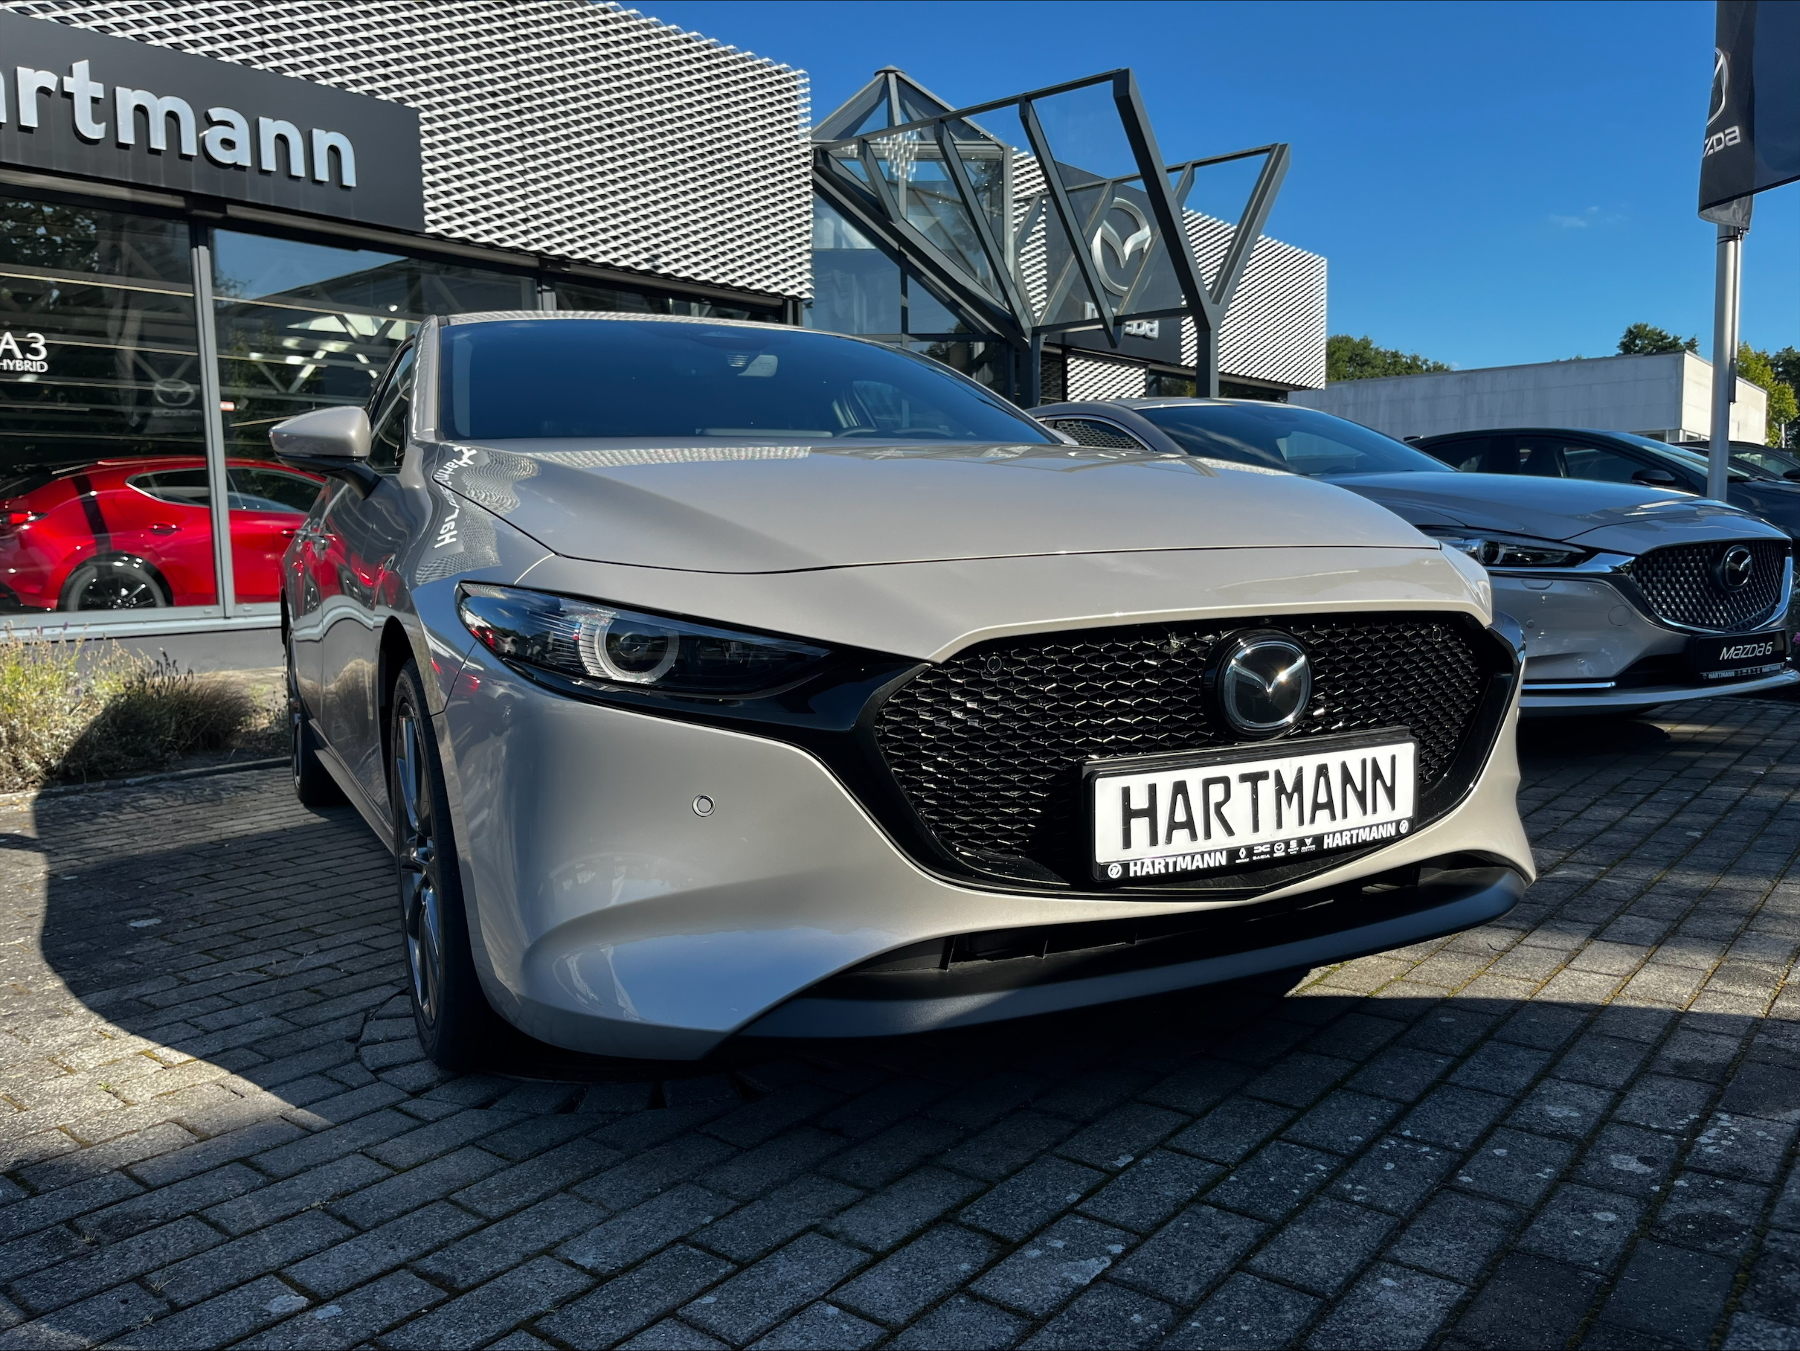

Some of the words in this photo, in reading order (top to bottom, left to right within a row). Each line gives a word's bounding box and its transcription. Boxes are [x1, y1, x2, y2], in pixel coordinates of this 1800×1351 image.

[0, 59, 357, 188] rtmann
[1120, 753, 1397, 850] HARTMANN
[1128, 850, 1227, 877] HARTMANN
[1323, 823, 1396, 850] HARTMANN
